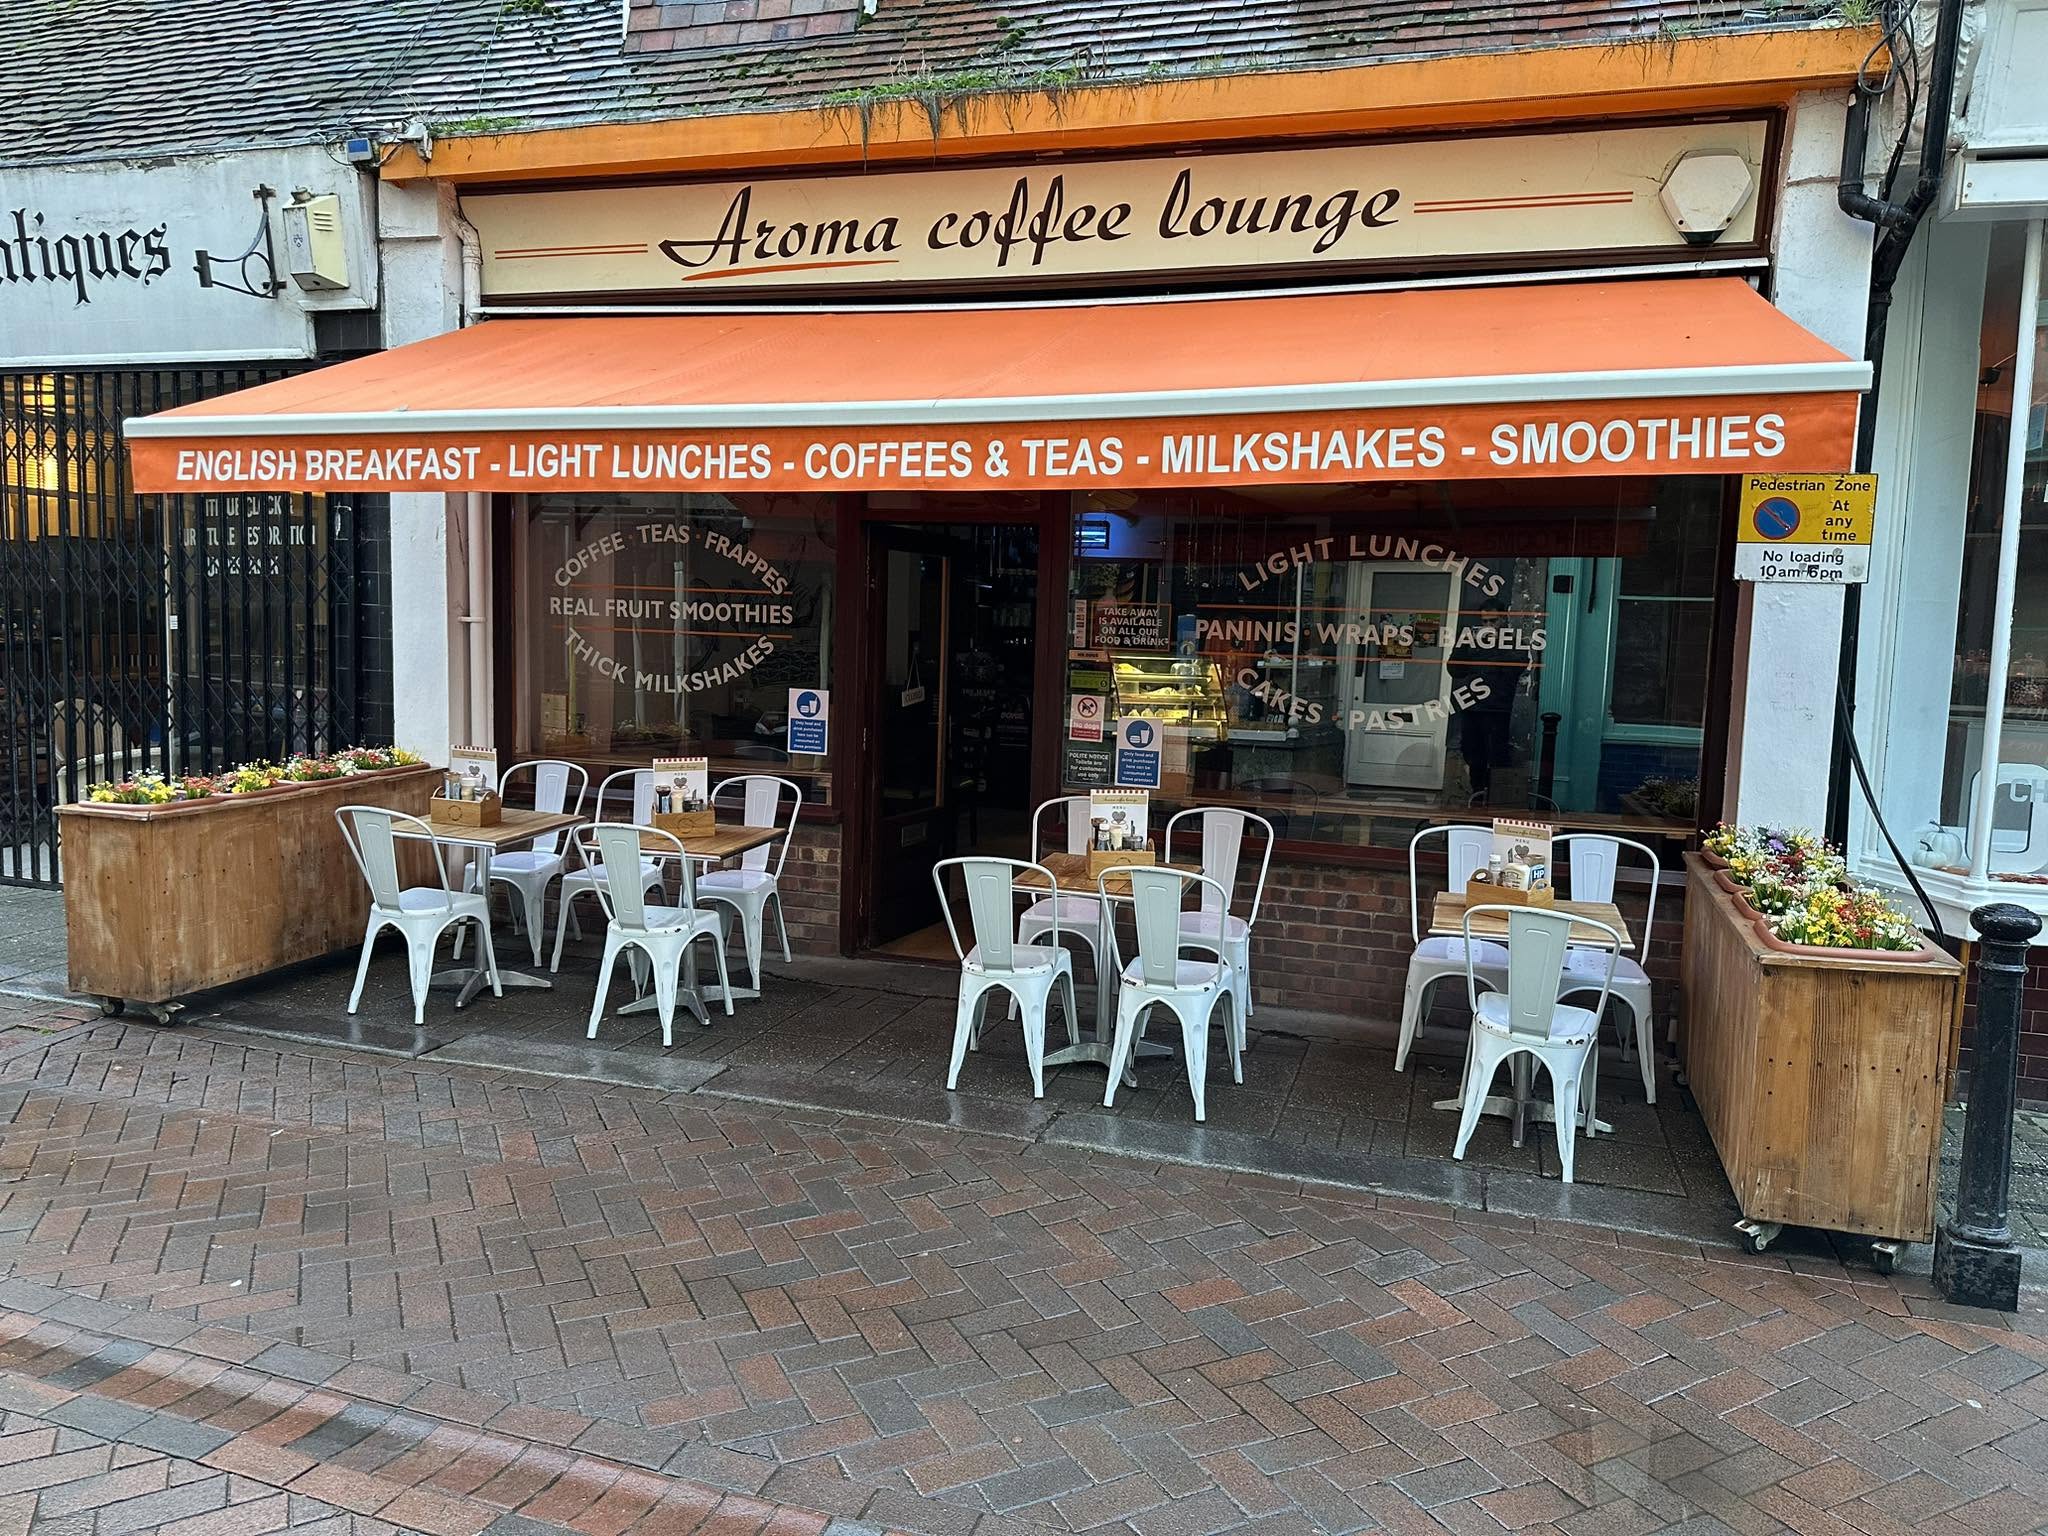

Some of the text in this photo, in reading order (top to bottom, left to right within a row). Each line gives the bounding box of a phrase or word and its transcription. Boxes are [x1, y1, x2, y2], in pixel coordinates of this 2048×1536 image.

[658, 168, 1400, 268] Aroma coffee lounge
[176, 449, 297, 481] ENGLISH
[305, 447, 481, 481] BREAKFAST
[508, 444, 603, 478] LIGHT
[612, 443, 772, 479] LUNCHES
[803, 441, 973, 479] COFFEES
[984, 440, 1009, 478] &
[1021, 437, 1124, 476] TEAS
[1161, 426, 1446, 474] MILKSHAKES
[1489, 413, 1786, 466] SMOOTHIES
[1750, 479, 1871, 492] Pedestrian Zone
[1832, 500, 1850, 511] At
[1825, 517, 1853, 528] any
[1821, 530, 1857, 541] time
[554, 524, 788, 596] COFFEE TEAS FRAPPES
[1762, 550, 1844, 565] No loading
[1238, 537, 1335, 591] LIGHT
[1350, 535, 1506, 597] LUNCHES
[550, 597, 793, 625] REAL FRUIT SMOOTHIES
[1103, 608, 1159, 617] TAKE AWAY
[1098, 617, 1163, 626] IS AVAILABLE
[1101, 626, 1159, 636] ON ALL OUR
[1195, 619, 1547, 651] PANINIS WRAPS BAGELS
[1095, 636, 1121, 645] FOOD
[1123, 637, 1132, 646] &
[564, 627, 775, 694] THICK MILKSHAKES
[1237, 668, 1491, 731] CAKES PASTRIES
[1533, 869, 1545, 879] HP
